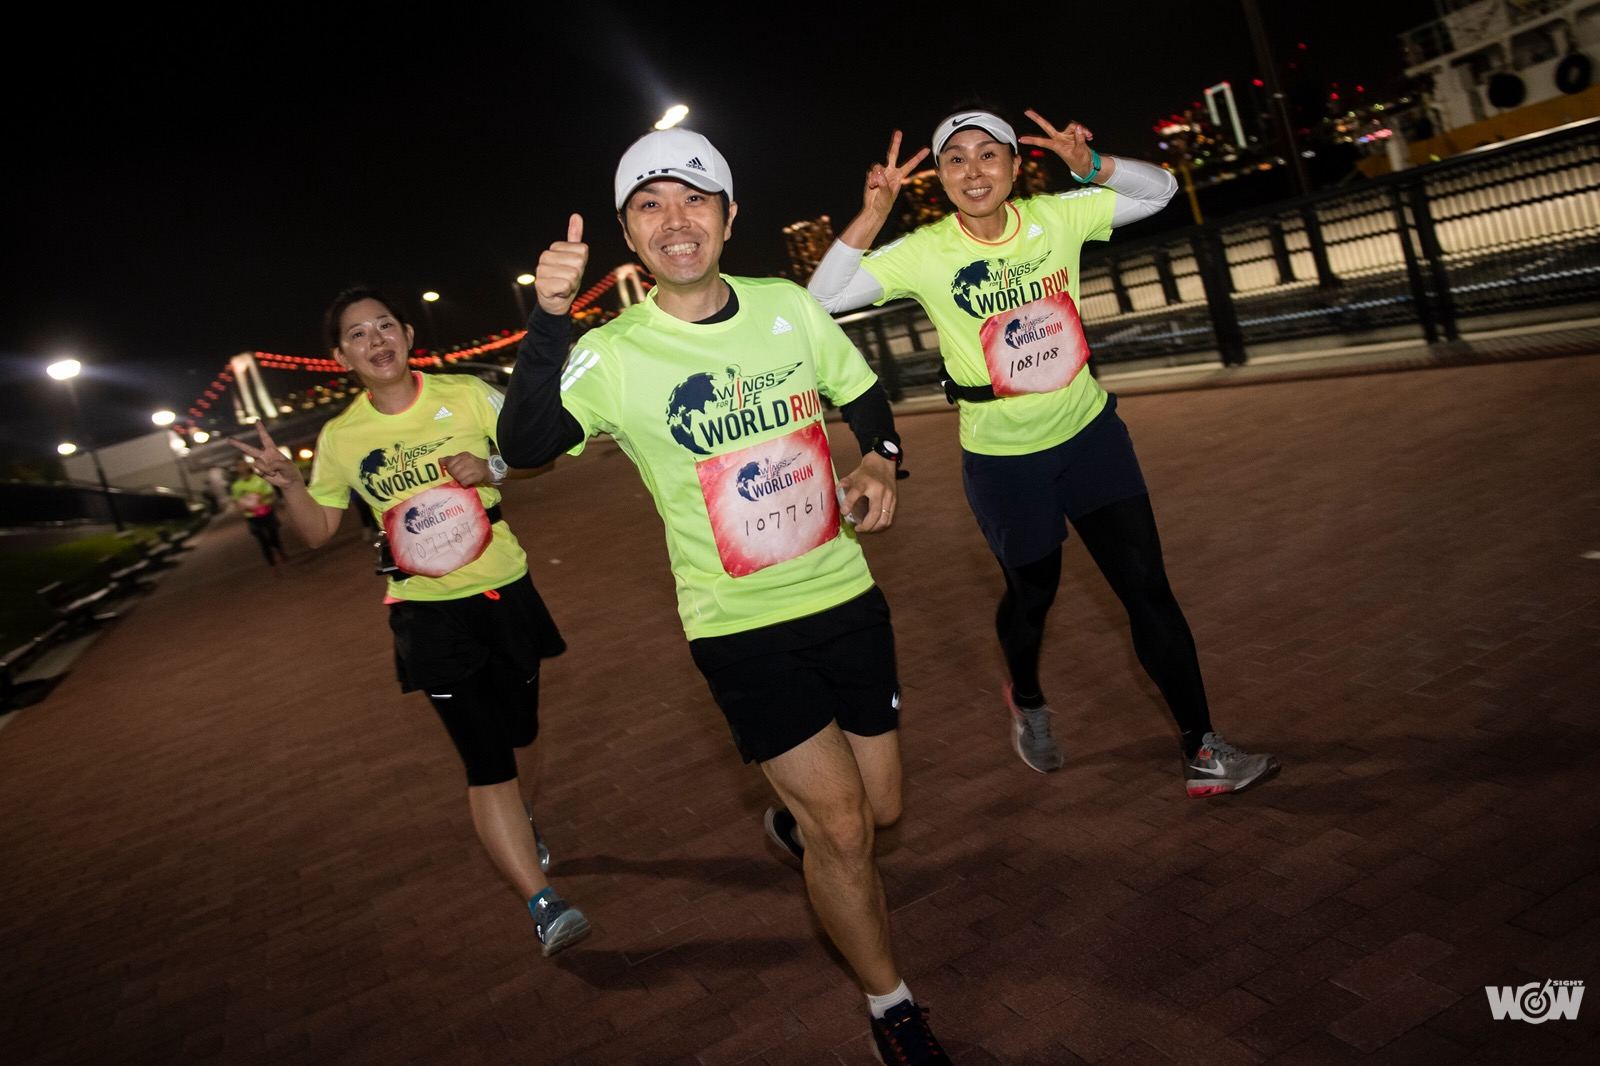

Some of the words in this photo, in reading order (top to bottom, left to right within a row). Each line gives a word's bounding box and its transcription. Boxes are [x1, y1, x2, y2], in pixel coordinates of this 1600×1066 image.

[990, 263, 1031, 284] WINGS
[999, 276, 1023, 290] LIFE
[976, 281, 1042, 315] WORLD
[1042, 266, 1069, 298] RUN
[1015, 327, 1046, 347] WORLD
[1045, 321, 1063, 337] RUN
[715, 373, 775, 400] WINGS
[729, 390, 762, 413] LIFE
[698, 399, 790, 448] WORLD
[789, 388, 821, 423] RUN
[386, 445, 428, 465] WINGS
[395, 458, 417, 474] LIFE
[377, 462, 439, 497] WORLD
[752, 473, 793, 498] WORLD
[792, 463, 814, 484] RUN
[414, 511, 447, 532] WORLD
[445, 503, 465, 520] RUN
[745, 492, 824, 536] 107761
